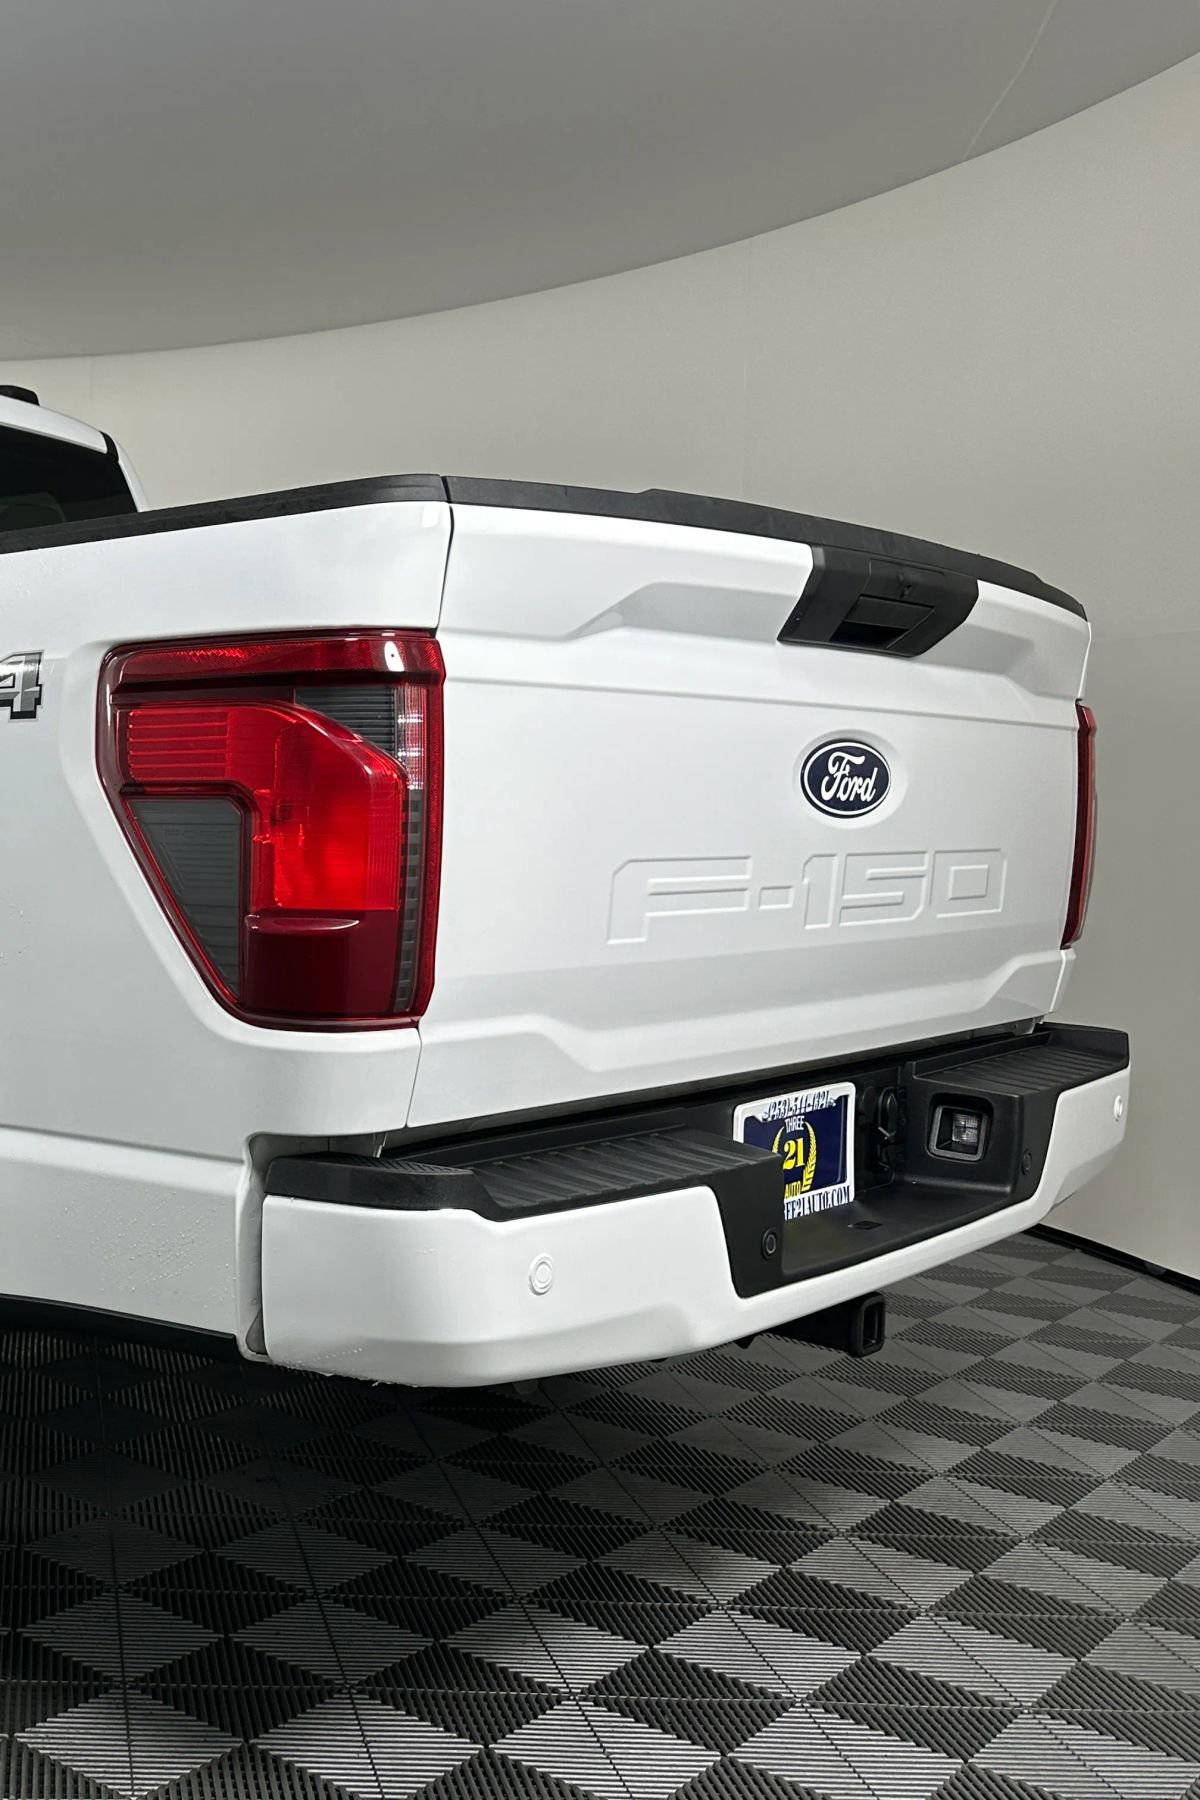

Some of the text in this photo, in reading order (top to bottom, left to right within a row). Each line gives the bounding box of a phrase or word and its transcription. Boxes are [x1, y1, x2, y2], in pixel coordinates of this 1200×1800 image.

[821, 751, 878, 802] Ford
[606, 848, 1007, 944] F-150
[784, 1115, 805, 1134] THREE
[783, 1137, 805, 1170] 21
[784, 1181, 801, 1199] AUTO
